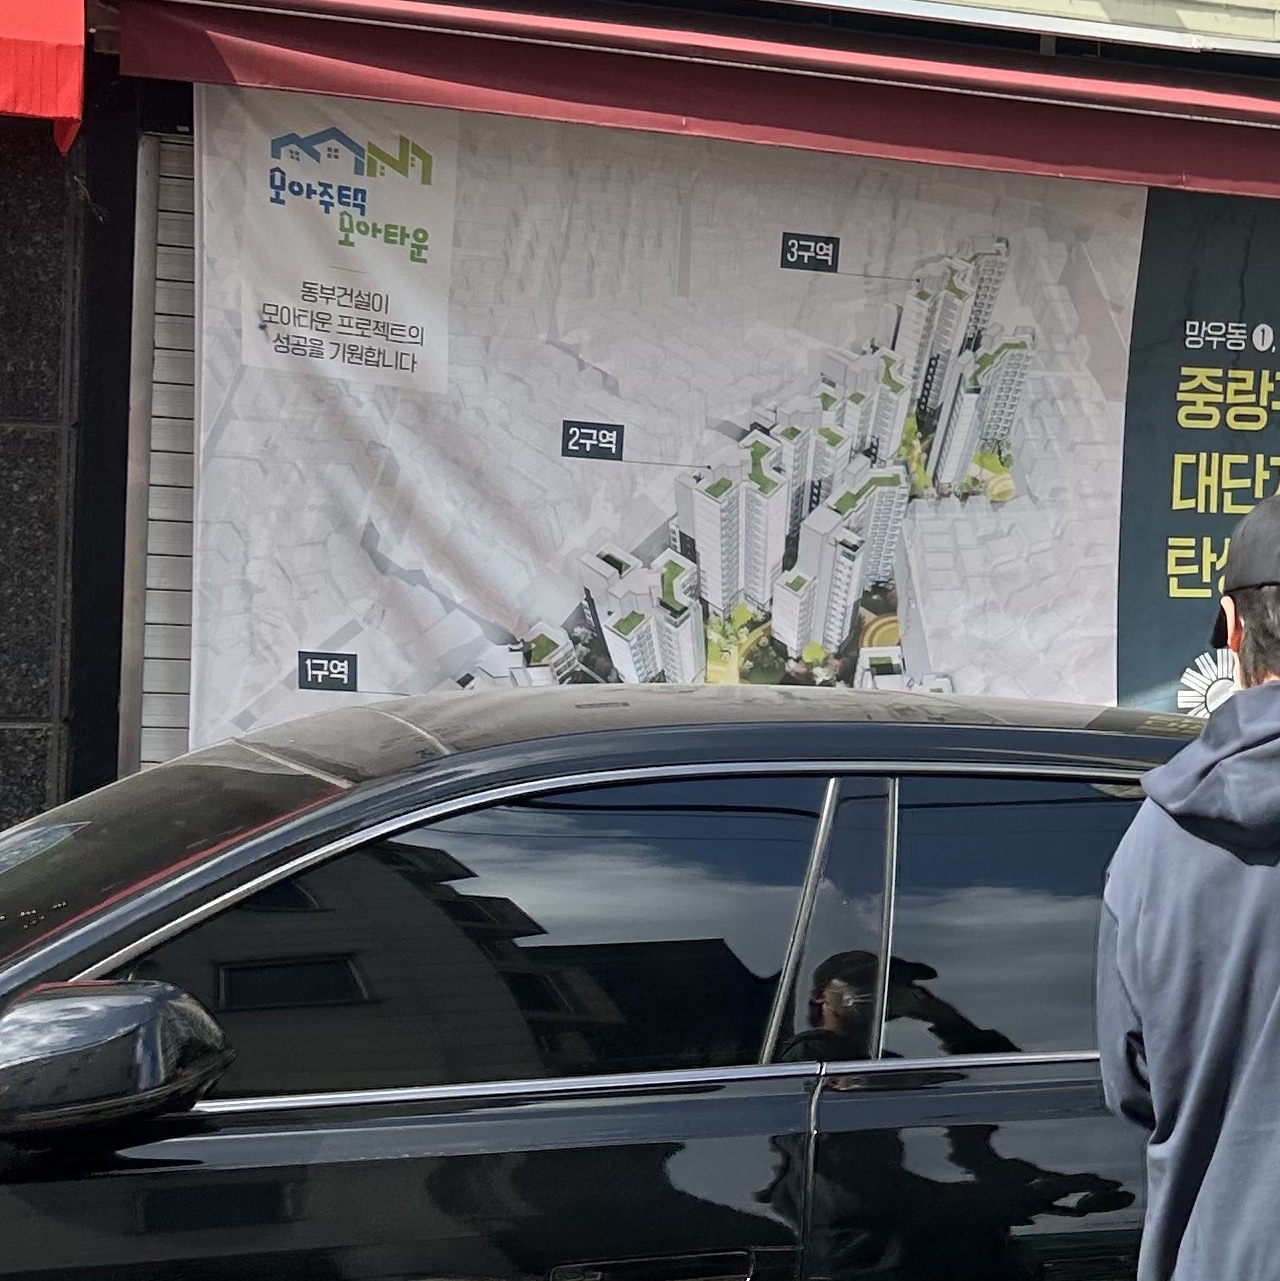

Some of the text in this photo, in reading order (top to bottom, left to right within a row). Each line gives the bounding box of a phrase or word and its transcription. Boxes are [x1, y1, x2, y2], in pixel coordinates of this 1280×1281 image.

[269, 166, 367, 216] 모아주택
[338, 210, 429, 264] 모아타운
[787, 239, 833, 265] 3구역
[300, 281, 390, 315] 동부건설이
[261, 302, 425, 347] 모아타운 프로젝트의
[1184, 320, 1248, 350] 망우동
[272, 333, 418, 373] 성공을 기원합니다
[567, 427, 617, 453] 2구역
[304, 658, 349, 684] 1구역
